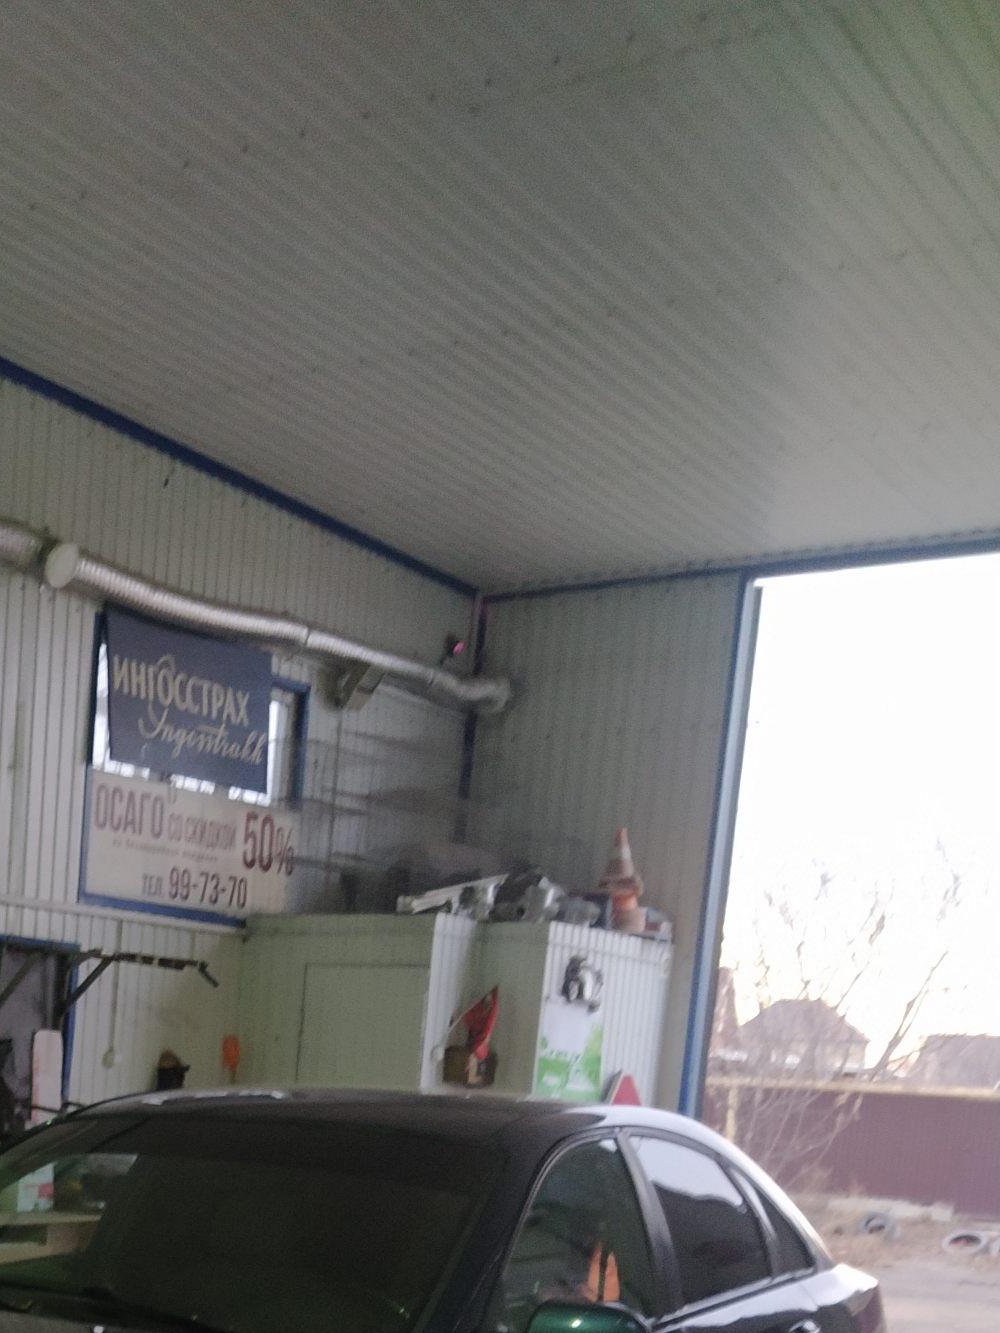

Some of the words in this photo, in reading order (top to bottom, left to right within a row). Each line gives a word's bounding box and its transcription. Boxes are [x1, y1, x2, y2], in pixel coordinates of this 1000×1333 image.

[112, 654, 250, 727] ИНГОССТРАХ
[94, 784, 164, 840] ОСАГО
[242, 810, 295, 877] 50%
[168, 866, 248, 909] 99-73-70
